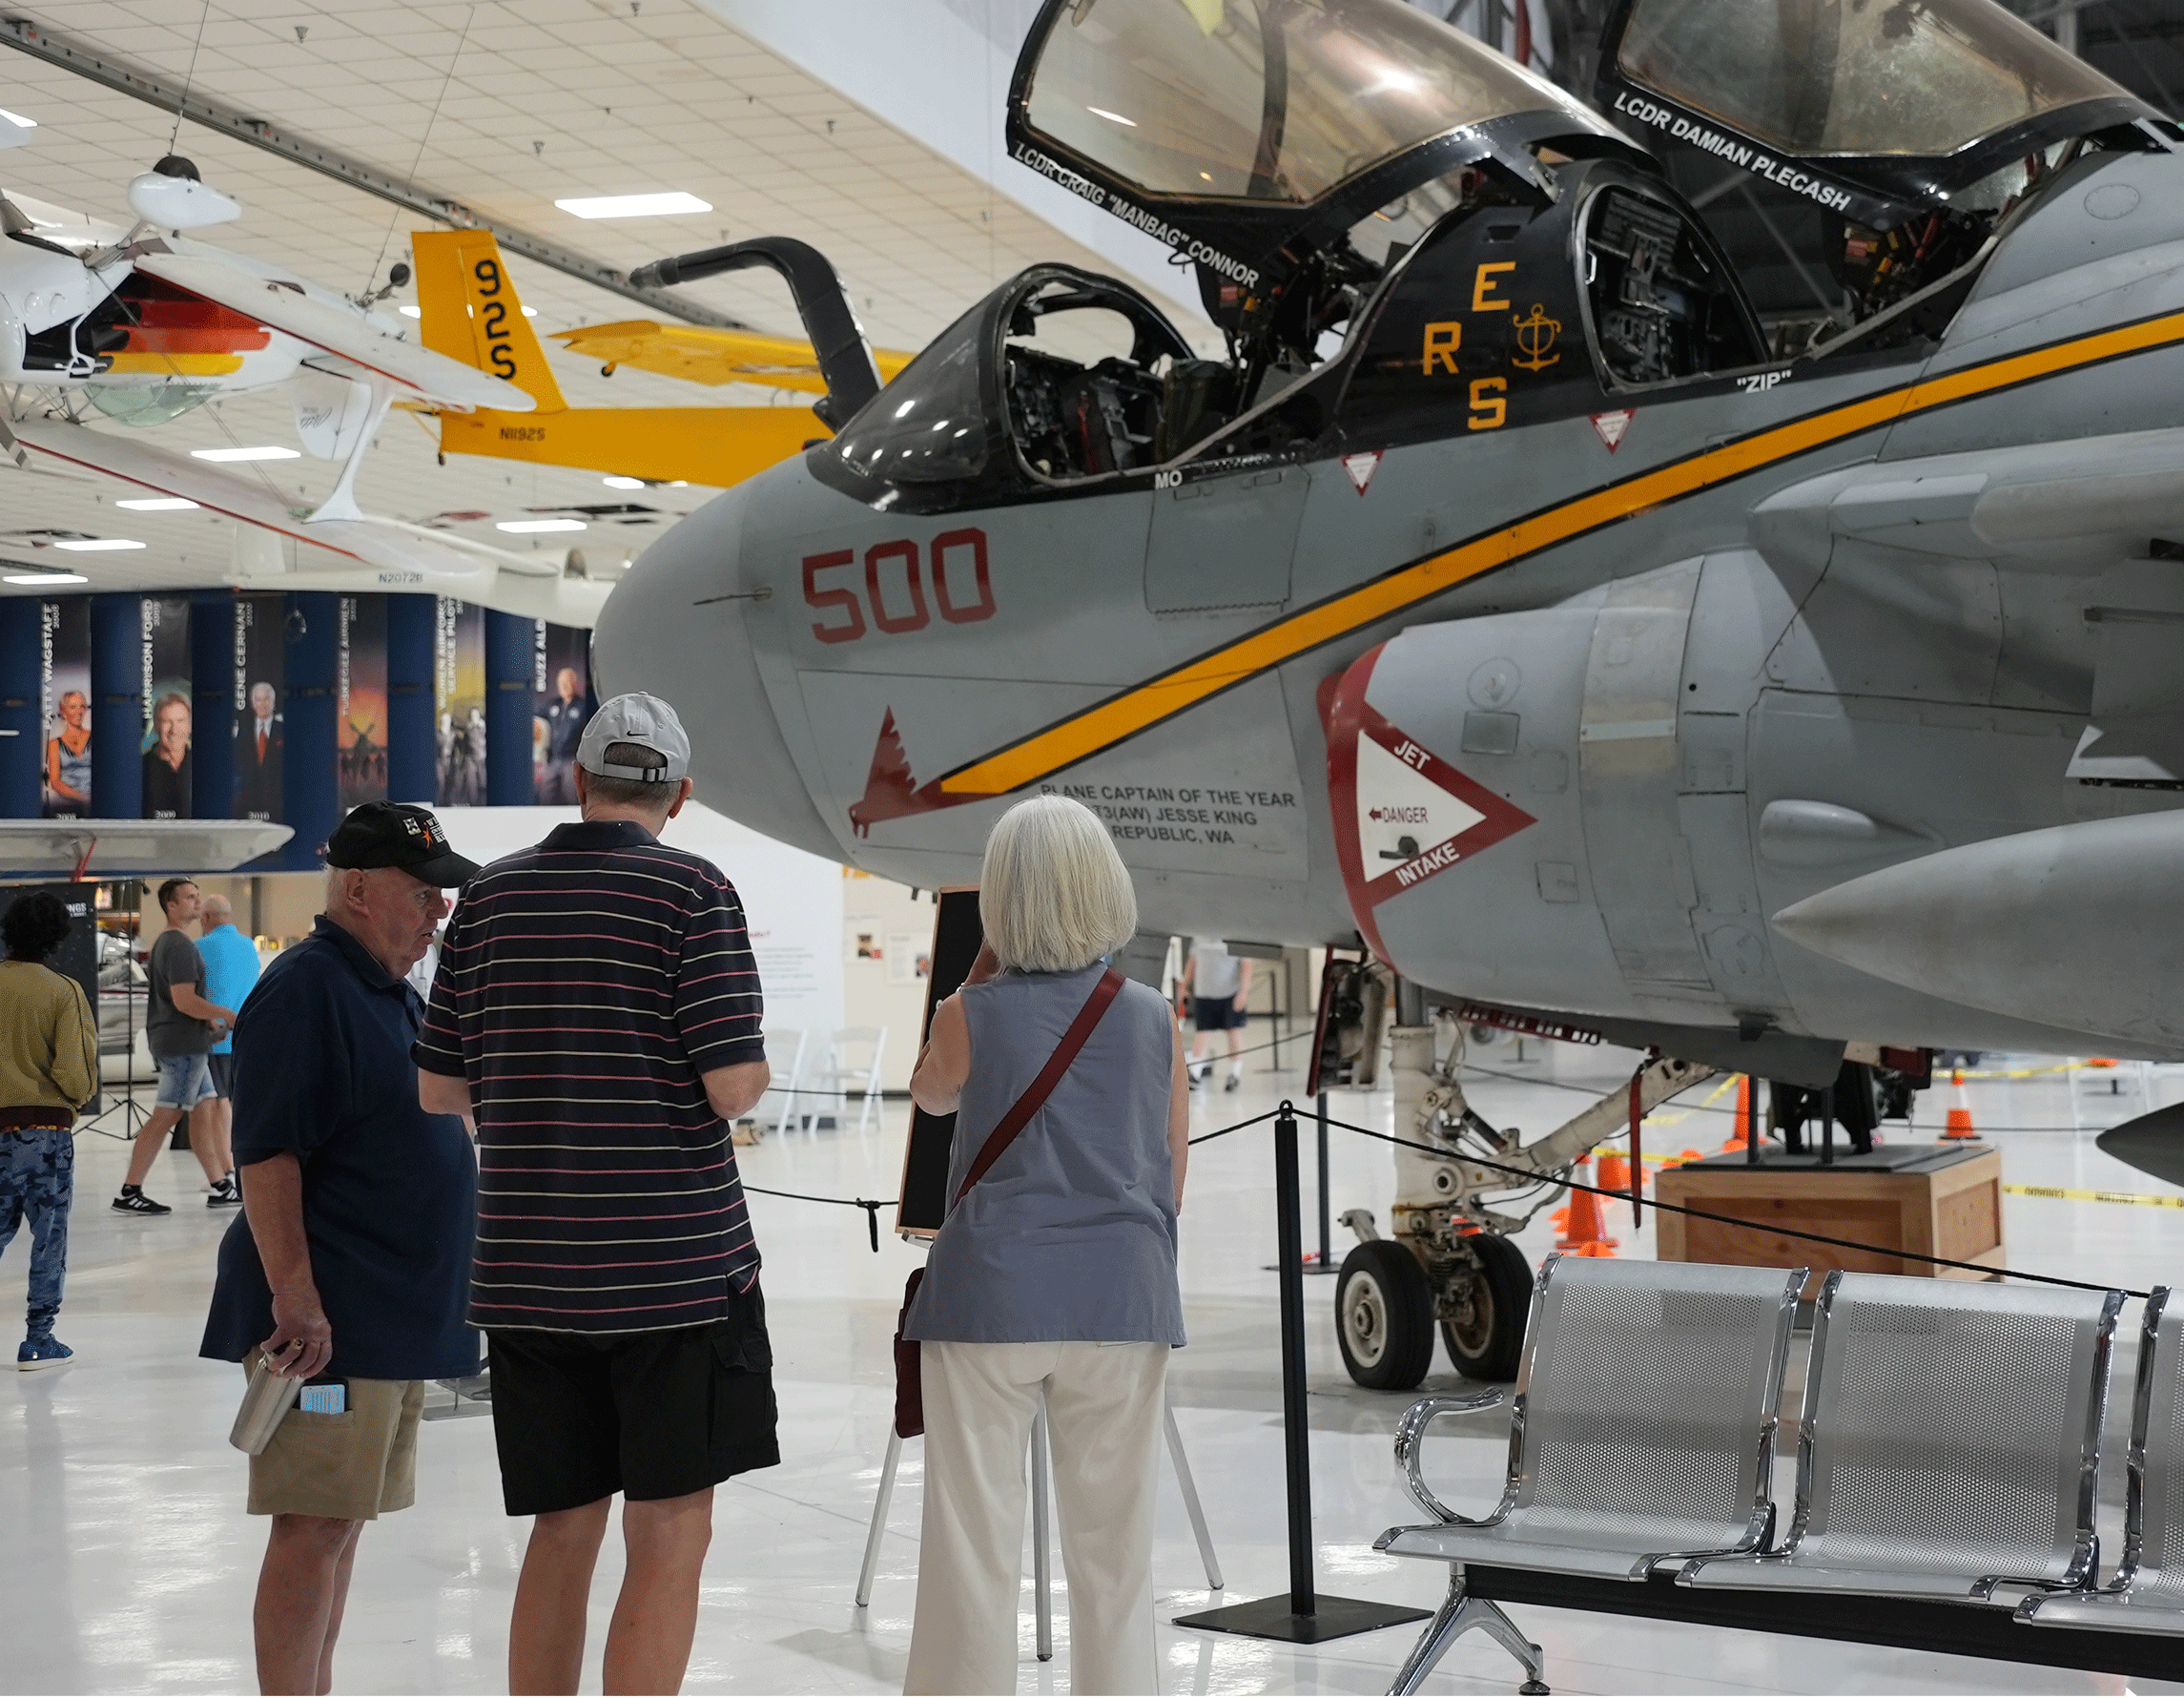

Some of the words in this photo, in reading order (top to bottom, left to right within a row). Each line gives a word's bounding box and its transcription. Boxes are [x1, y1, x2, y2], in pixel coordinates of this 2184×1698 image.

[1614, 91, 1673, 130] LCDR
[1670, 117, 1753, 168] DAMIAN
[1751, 155, 1852, 212] PLECASH
[1014, 142, 1055, 179] LCDR
[1057, 166, 1106, 205] CRAIG
[1108, 195, 1190, 247] "MANBAG"
[1188, 240, 1261, 289] CONNOR
[1472, 260, 1517, 313] E
[1422, 321, 1462, 376] R
[1467, 376, 1508, 430] S
[1737, 369, 1793, 394] "ZIP"
[802, 527, 998, 645] 500
[141, 598, 153, 641] FORD
[235, 602, 246, 667] CERNAN
[447, 597, 457, 637] PILOT
[535, 618, 546, 650] ALD
[42, 603, 52, 683] WAGSTAFF
[141, 642, 153, 720] HARRISON
[235, 668, 246, 712] GENE
[535, 652, 546, 693] BUZZ
[42, 684, 52, 731] PATTY
[1393, 740, 1432, 770] JET
[1101, 786, 1174, 803] CAPTAIN
[1179, 789, 1202, 804] OF
[1206, 790, 1242, 806] THE
[1245, 792, 1296, 808] YEAR
[1156, 808, 1209, 825] JESSE
[1214, 811, 1258, 826] KING
[1382, 807, 1429, 823] DANGER
[1112, 825, 1204, 844] REPUBLIC,
[1206, 830, 1235, 844] WA
[1395, 841, 1460, 887] INTAKE
